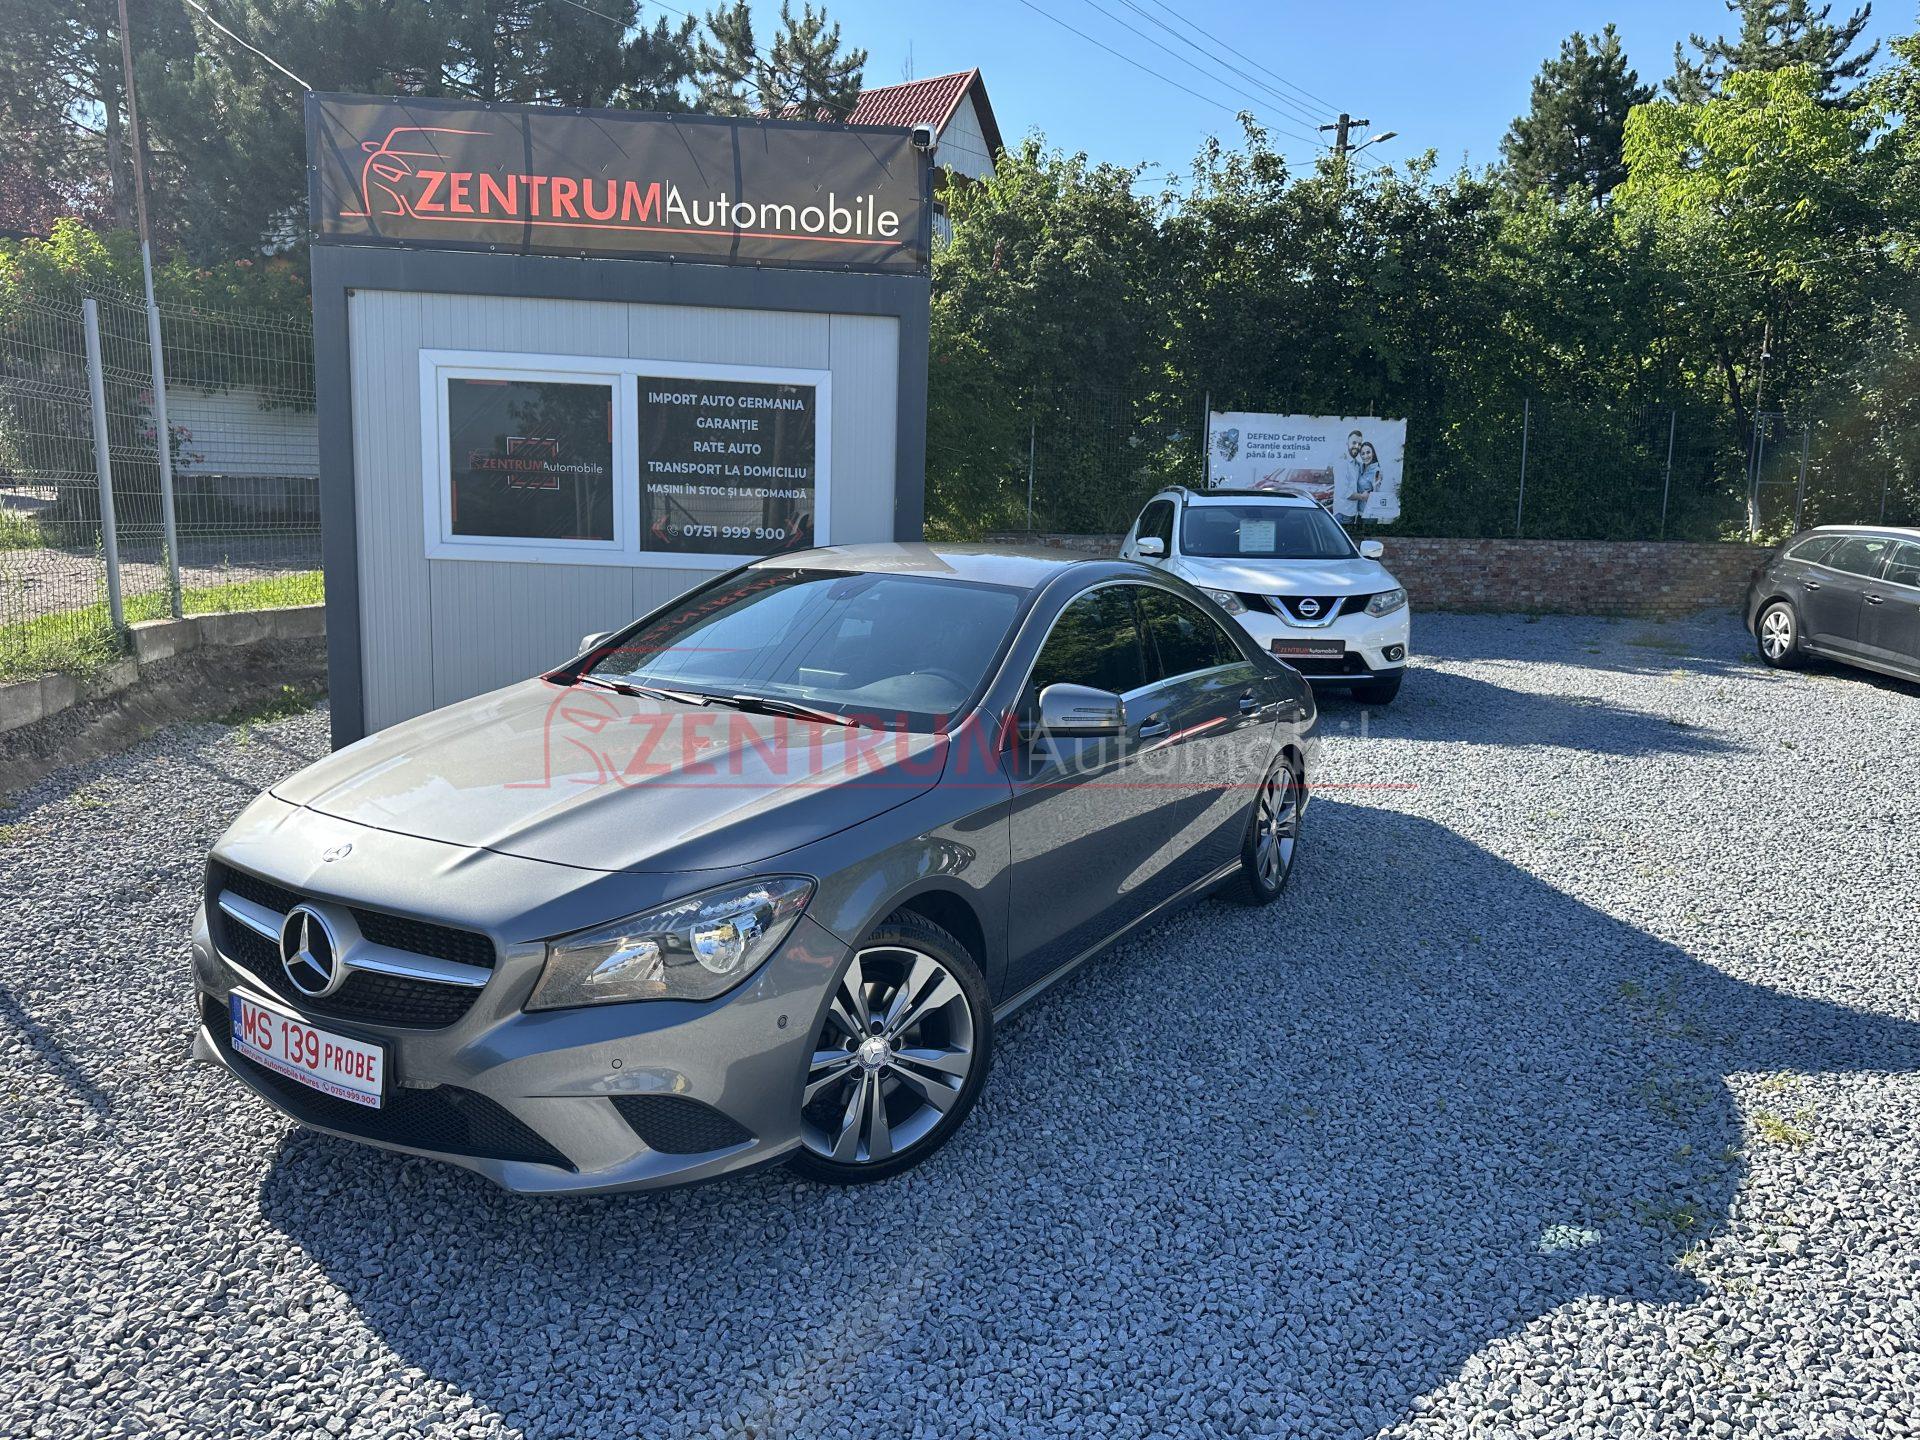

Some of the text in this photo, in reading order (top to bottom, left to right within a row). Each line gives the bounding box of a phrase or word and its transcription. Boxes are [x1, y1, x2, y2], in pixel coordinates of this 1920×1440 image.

[415, 170, 900, 237] ZENTRUM Automobile
[648, 392, 805, 411] IMPORT AUTO GERMANIA
[696, 417, 759, 434] GARANȚIE
[1247, 433, 1280, 441] DEFEND
[693, 441, 761, 455] RATE AUTO
[1246, 451, 1266, 459] până
[1268, 451, 1275, 459] la
[1283, 451, 1296, 459] ani
[482, 459, 603, 474] ZENTRUM Automobile
[648, 461, 807, 479] TRANSPORT LA DOMICILIU
[647, 483, 807, 499] MAȘINI ÎN STOC ȘI LA COMANDĂ
[683, 524, 785, 540] 0751 999 900
[243, 1003, 376, 1082] MS 139 PROBE
[263, 1059, 299, 1080] Automobile
